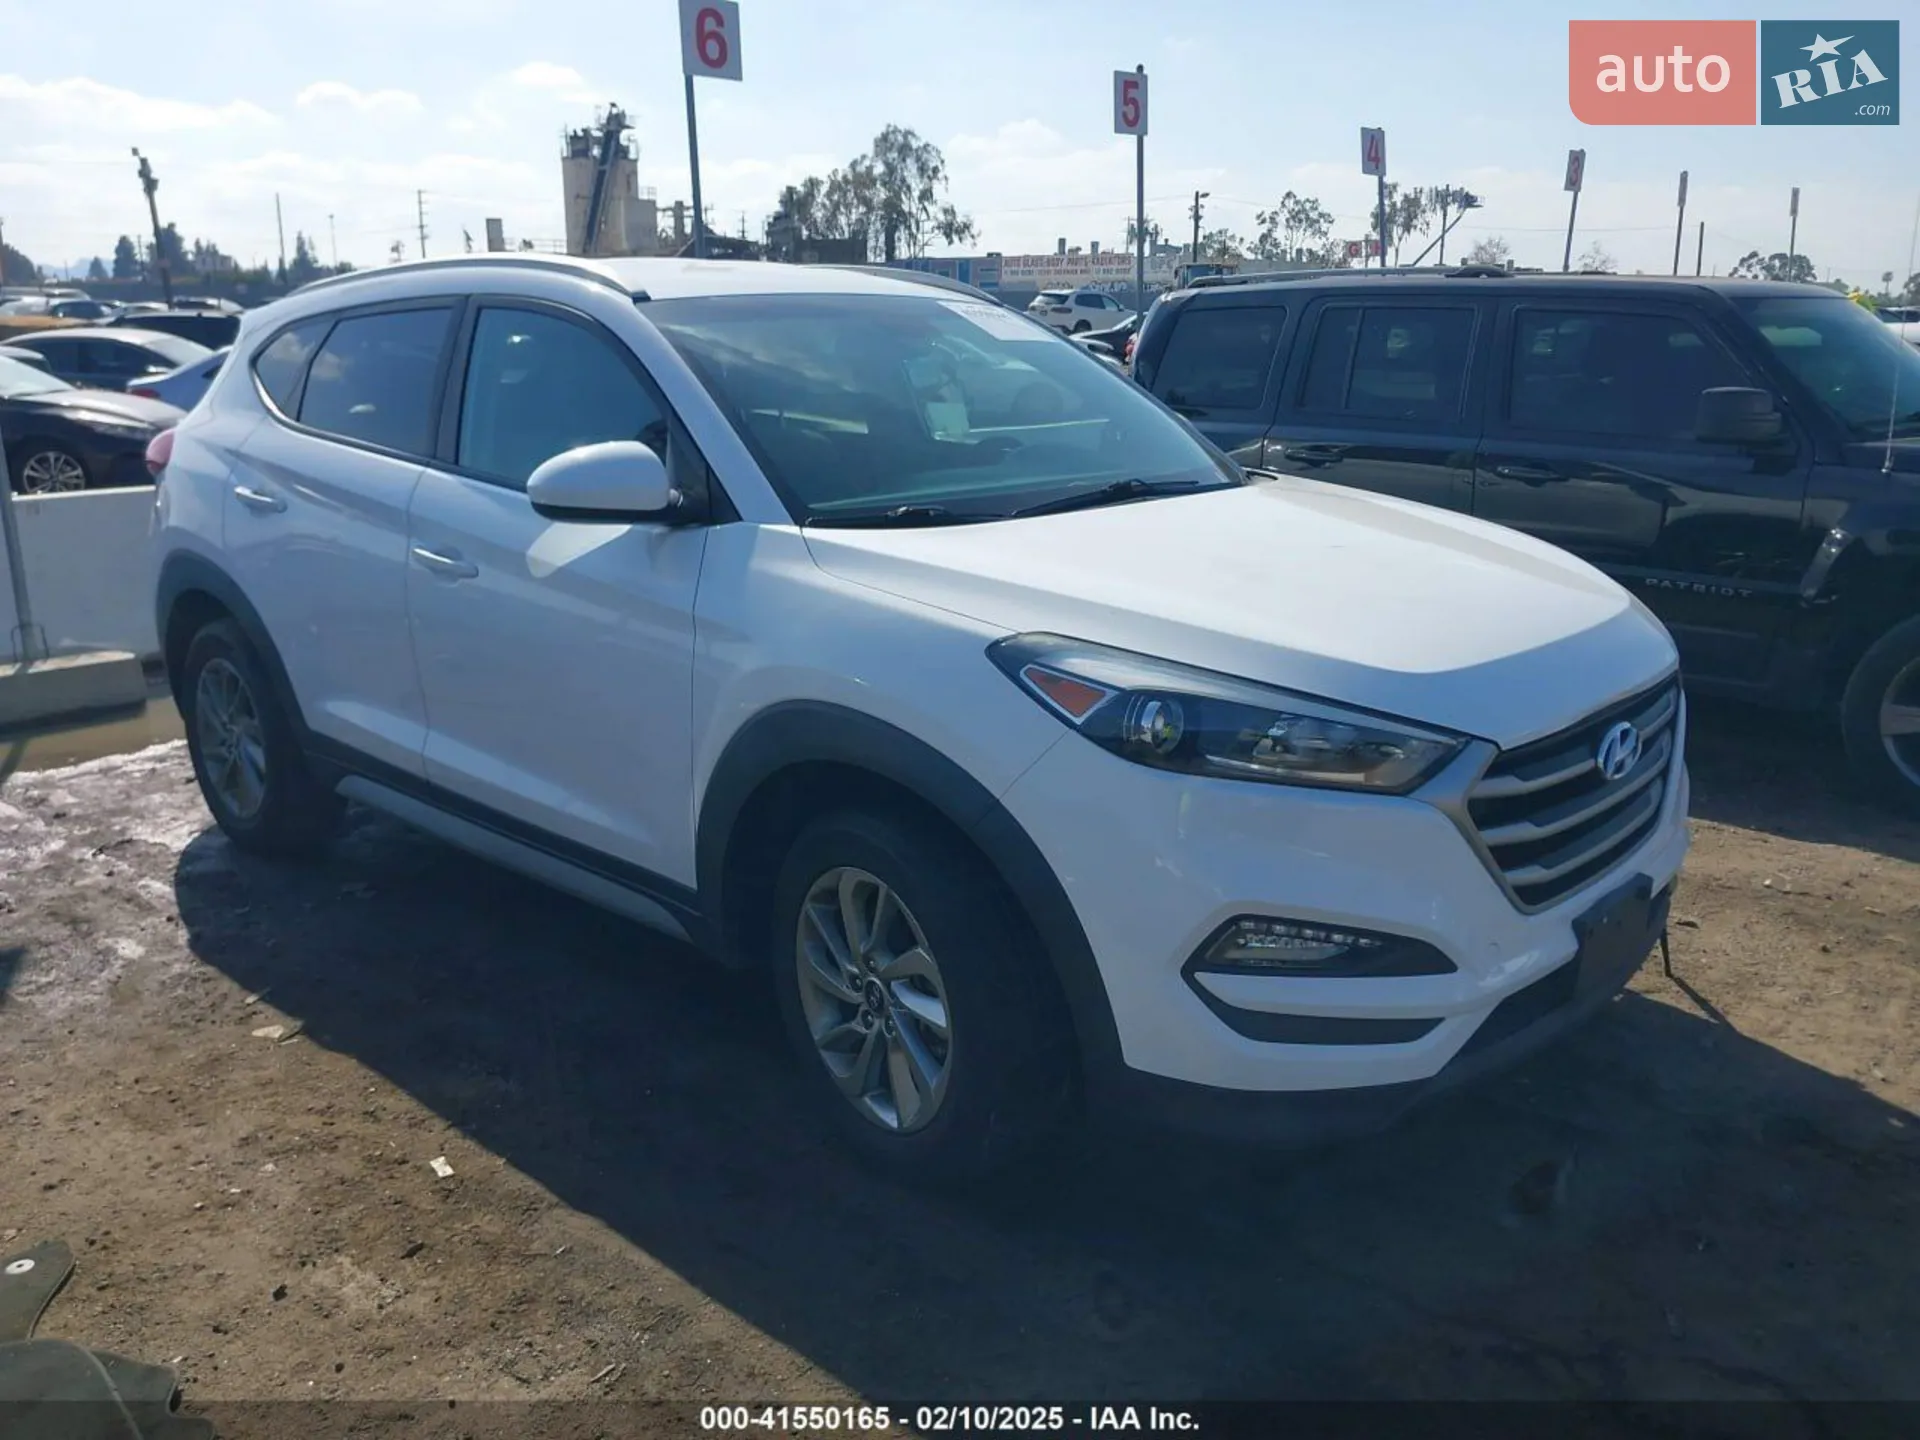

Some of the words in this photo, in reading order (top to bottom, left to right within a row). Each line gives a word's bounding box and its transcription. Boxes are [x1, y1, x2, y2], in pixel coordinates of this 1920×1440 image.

[695, 7, 729, 69] 6
[1122, 80, 1141, 128] 5
[1367, 133, 1382, 170] 4
[1569, 155, 1581, 187] 3
[1645, 578, 1753, 597] PATRIOT
